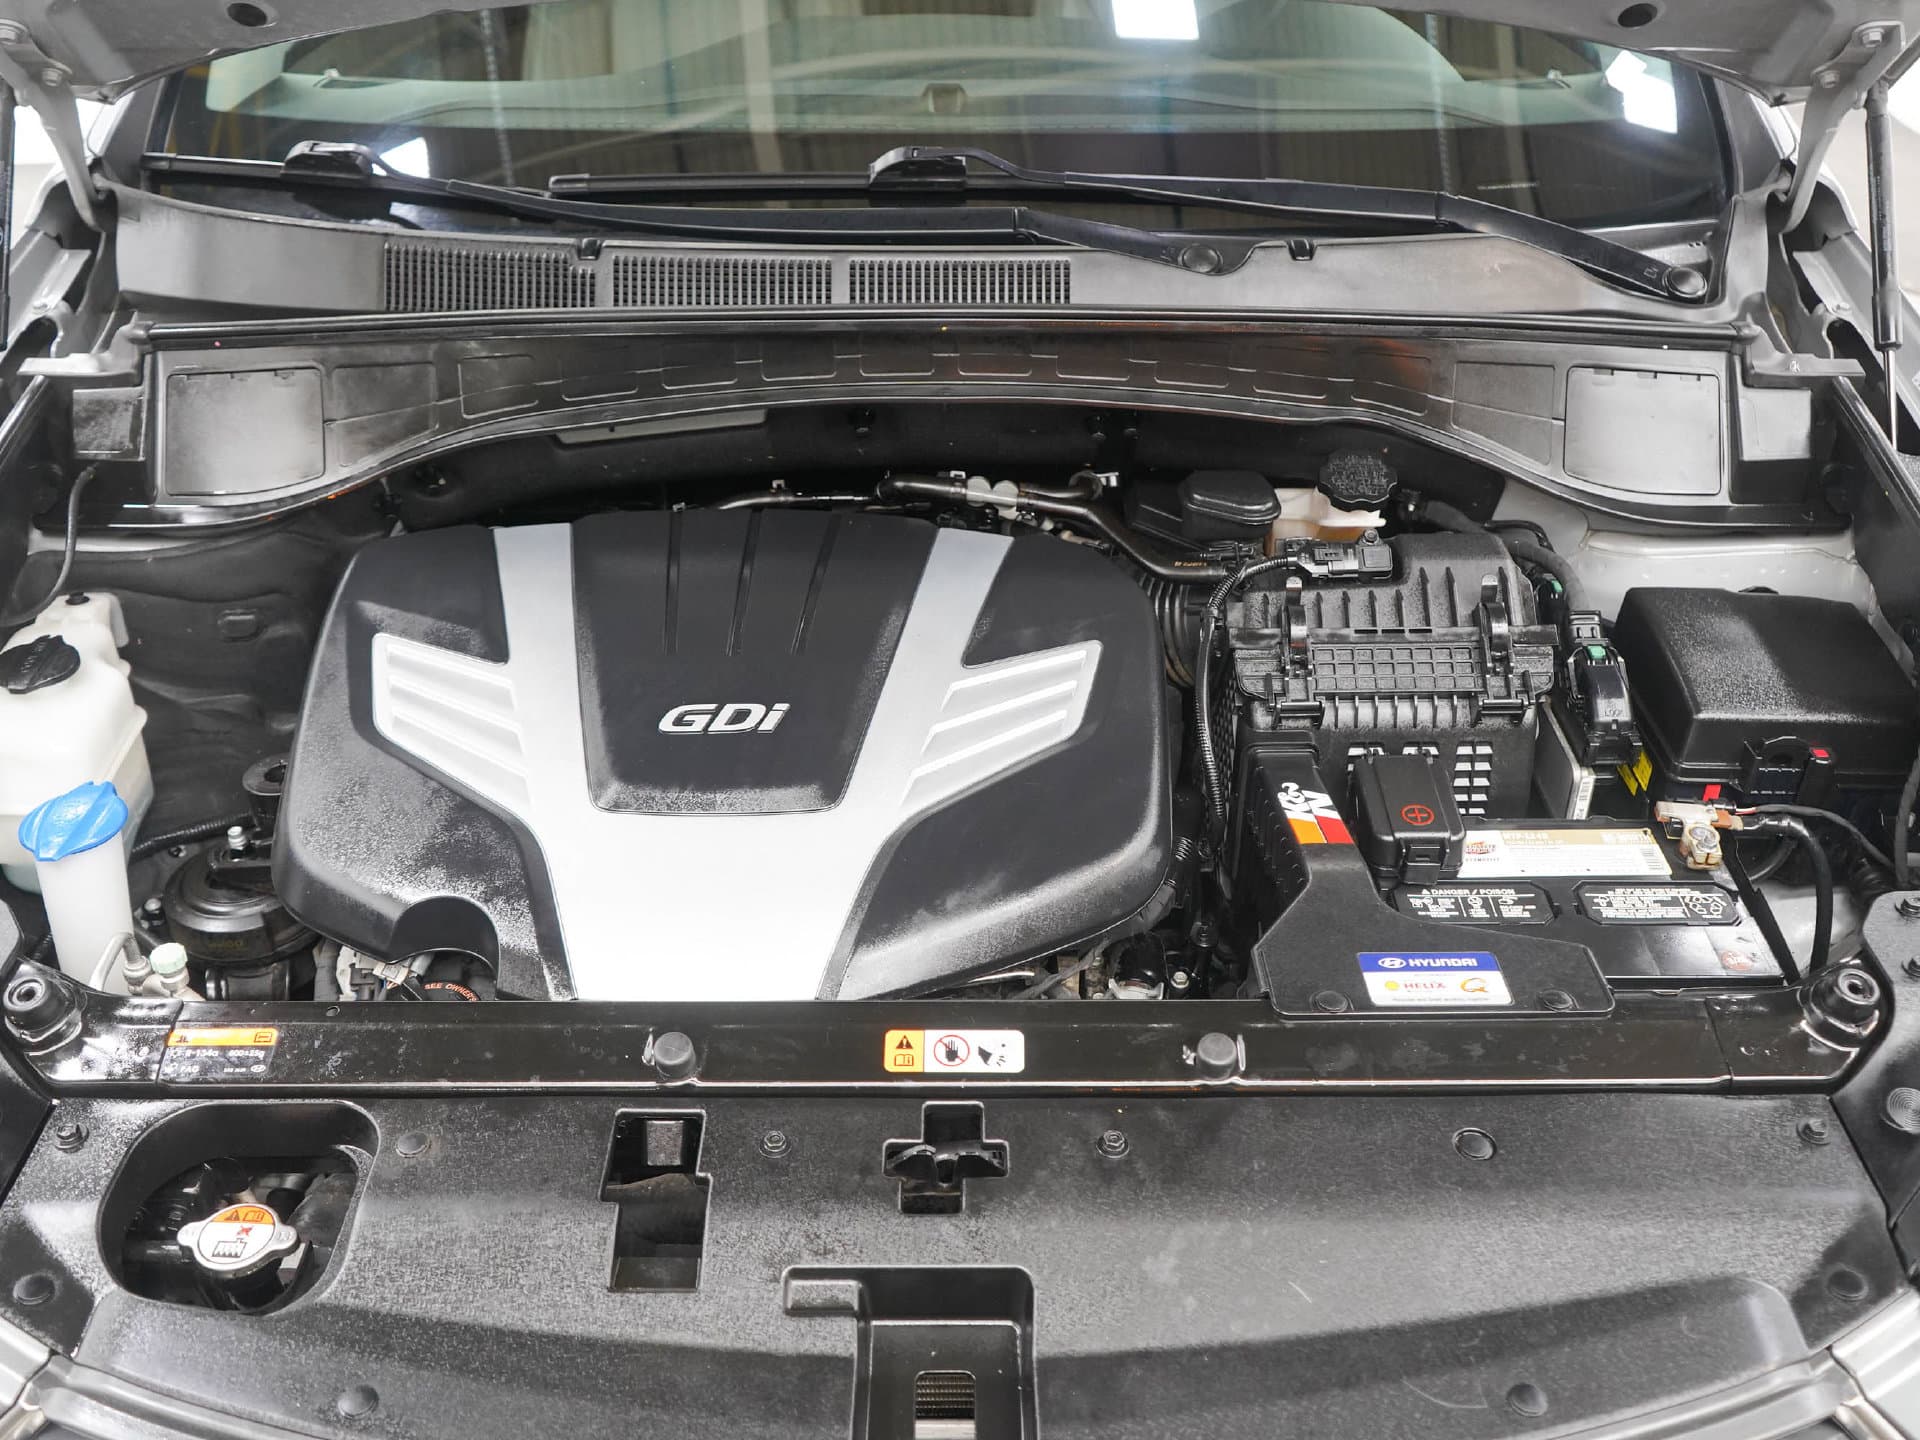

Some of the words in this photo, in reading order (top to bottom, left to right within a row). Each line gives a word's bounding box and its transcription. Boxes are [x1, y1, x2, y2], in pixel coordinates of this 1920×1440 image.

[658, 703, 790, 734] GDi
[1277, 782, 1342, 821] K&N
[1408, 957, 1478, 967] HYUNDAI
[424, 982, 443, 990] SEE
